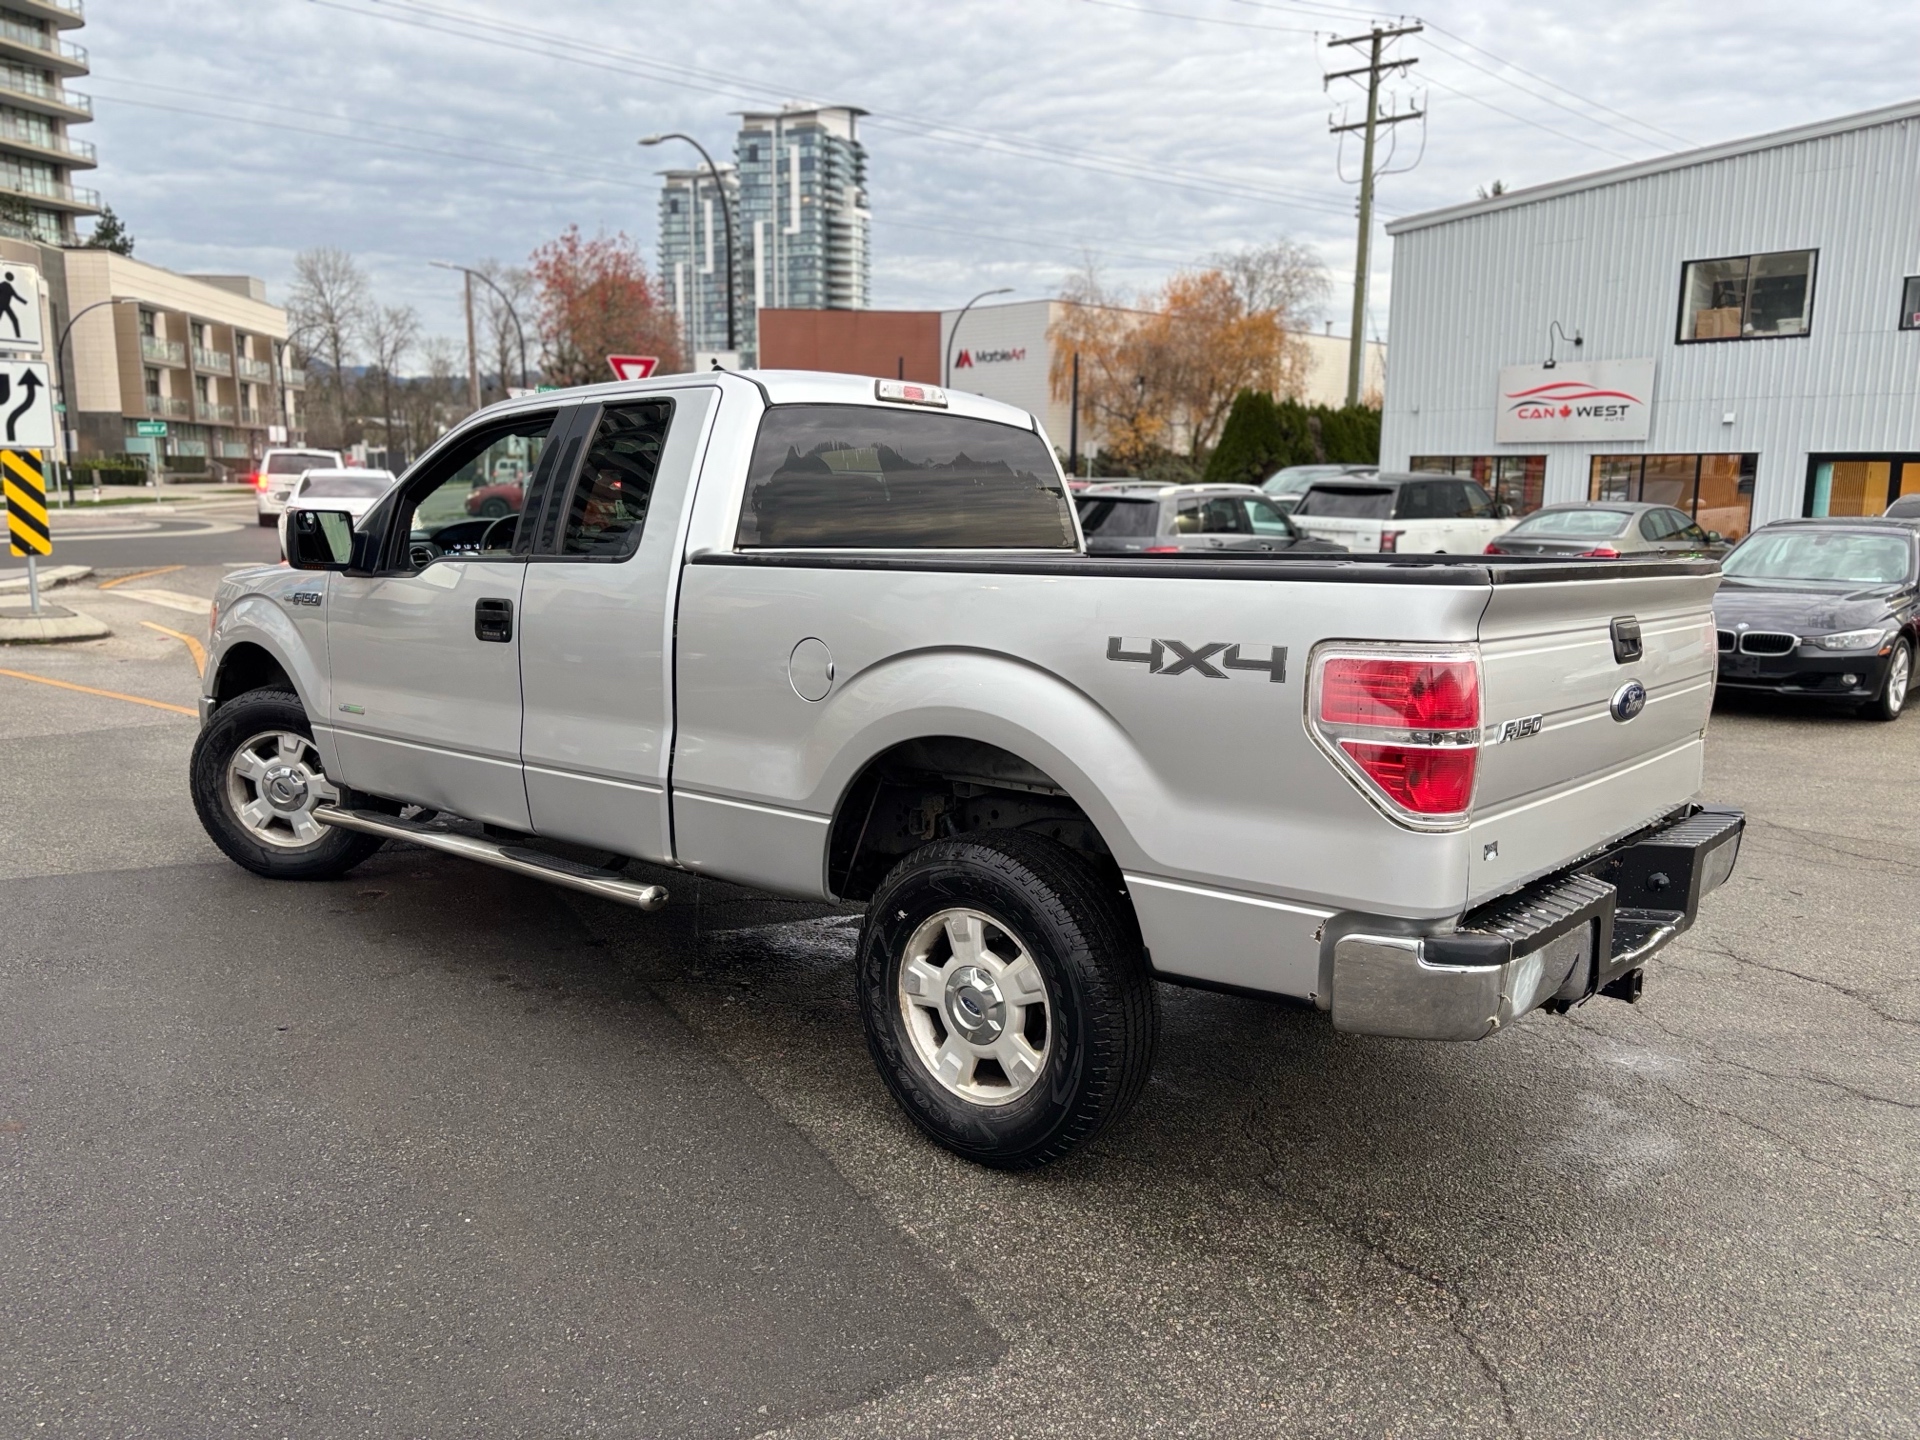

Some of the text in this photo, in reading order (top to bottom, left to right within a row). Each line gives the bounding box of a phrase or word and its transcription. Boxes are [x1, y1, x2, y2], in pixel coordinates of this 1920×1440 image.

[1517, 405, 1630, 419] CAN WEST
[1625, 690, 1644, 714] Ford
[1502, 714, 1543, 742] F-150
